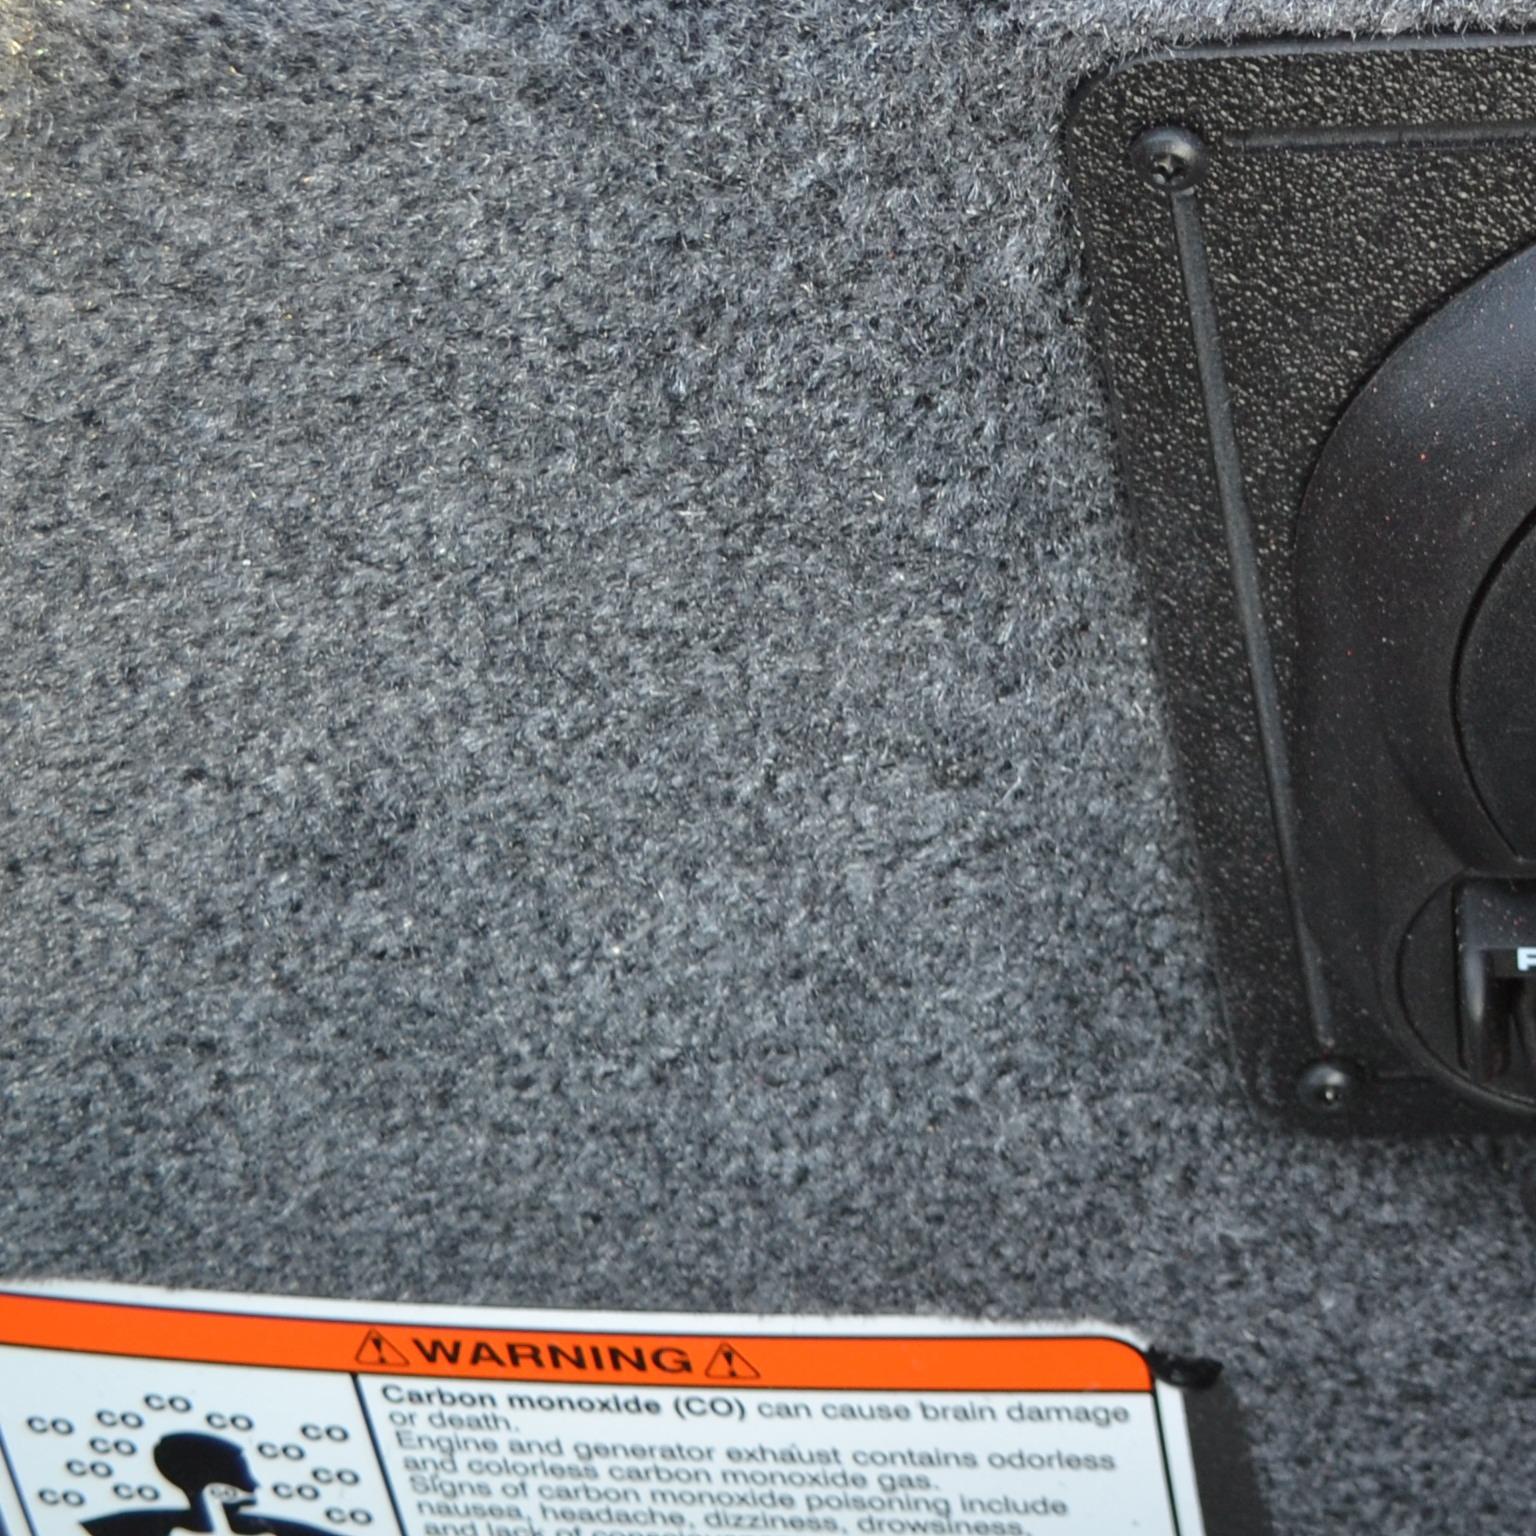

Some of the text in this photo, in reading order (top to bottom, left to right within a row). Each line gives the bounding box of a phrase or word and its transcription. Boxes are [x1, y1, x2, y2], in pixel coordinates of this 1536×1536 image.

[412, 1338, 694, 1374] WARNING
[144, 1394, 192, 1413] CO
[381, 1383, 1130, 1427] Carbon monoxide (CO) can cause brain damage
[26, 1416, 75, 1435] CO
[96, 1410, 144, 1429] CO
[205, 1412, 254, 1431] CO
[389, 1409, 521, 1433] or death.
[301, 1424, 349, 1442] CO
[89, 1438, 136, 1456] CO
[257, 1443, 305, 1461] CO
[396, 1431, 1116, 1471] Engine and generator exhaust contains odorless
[66, 1460, 113, 1478] CO
[312, 1467, 360, 1485] CO
[403, 1454, 940, 1493] and colorless carbon monoxide gas.
[38, 1489, 85, 1507] CO
[112, 1483, 160, 1501] CO
[272, 1483, 320, 1500] CO
[411, 1474, 1068, 1519] Signs of carbon monoxide poisoning include
[325, 1507, 373, 1525] CO
